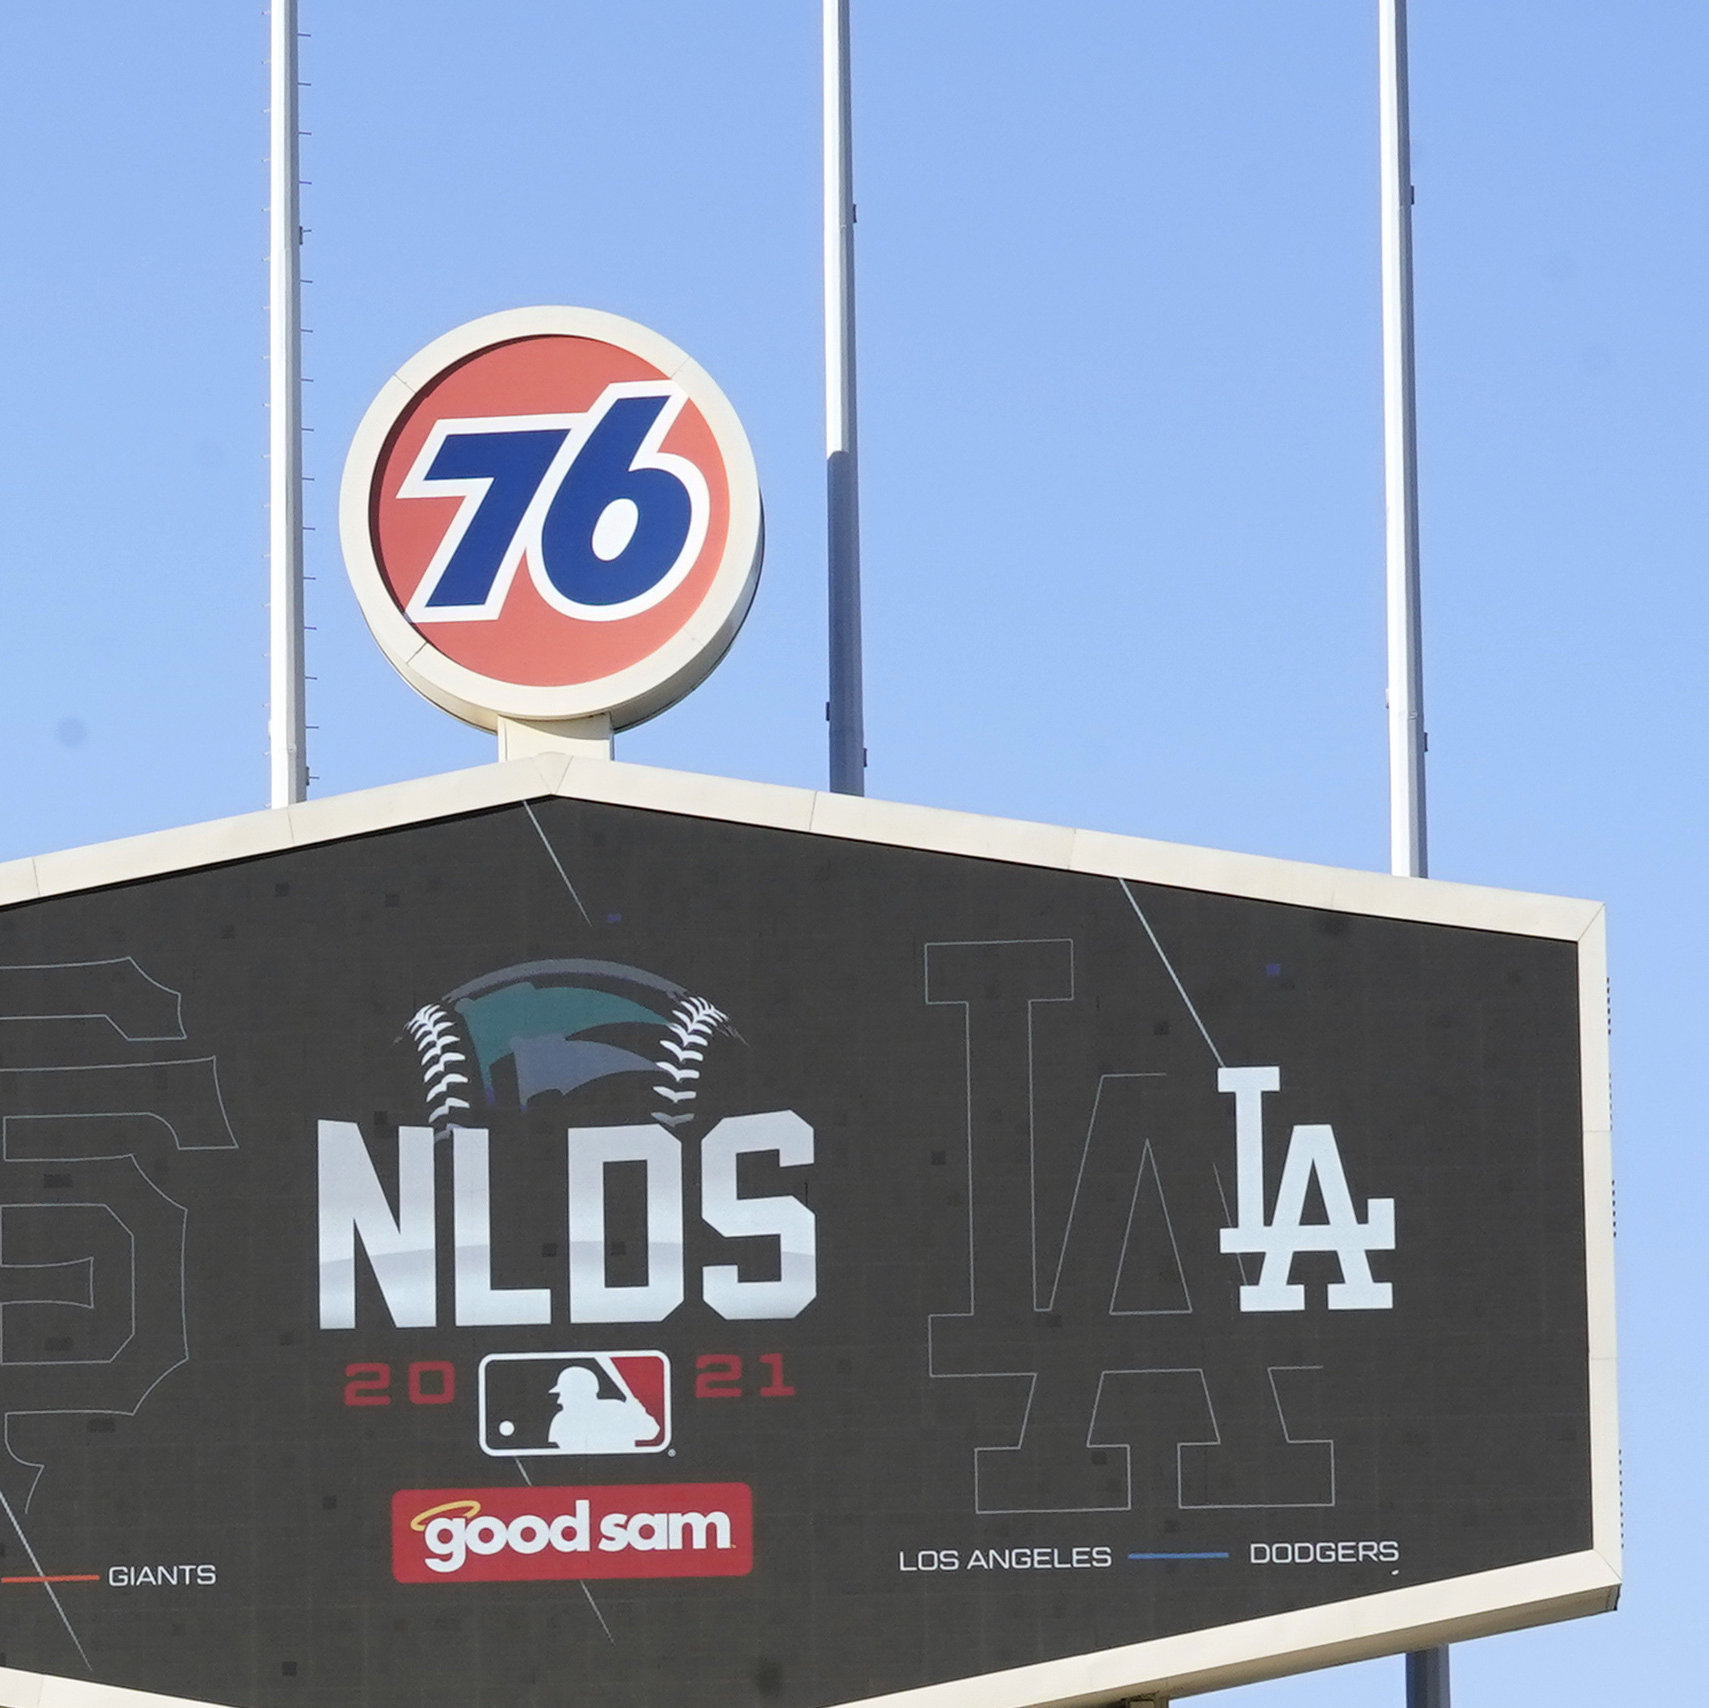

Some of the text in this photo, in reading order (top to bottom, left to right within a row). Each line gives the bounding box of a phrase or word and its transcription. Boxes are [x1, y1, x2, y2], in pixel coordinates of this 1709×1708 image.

[396, 380, 710, 622] 76
[317, 1108, 817, 1330] NLDS
[1217, 1066, 1396, 1312] LA
[344, 1353, 795, 1406] 20 21
[424, 1499, 731, 1573] good sam
[899, 1540, 1400, 1572] LOS ANGELES DODGERS
[108, 1564, 217, 1587] GIANTS
